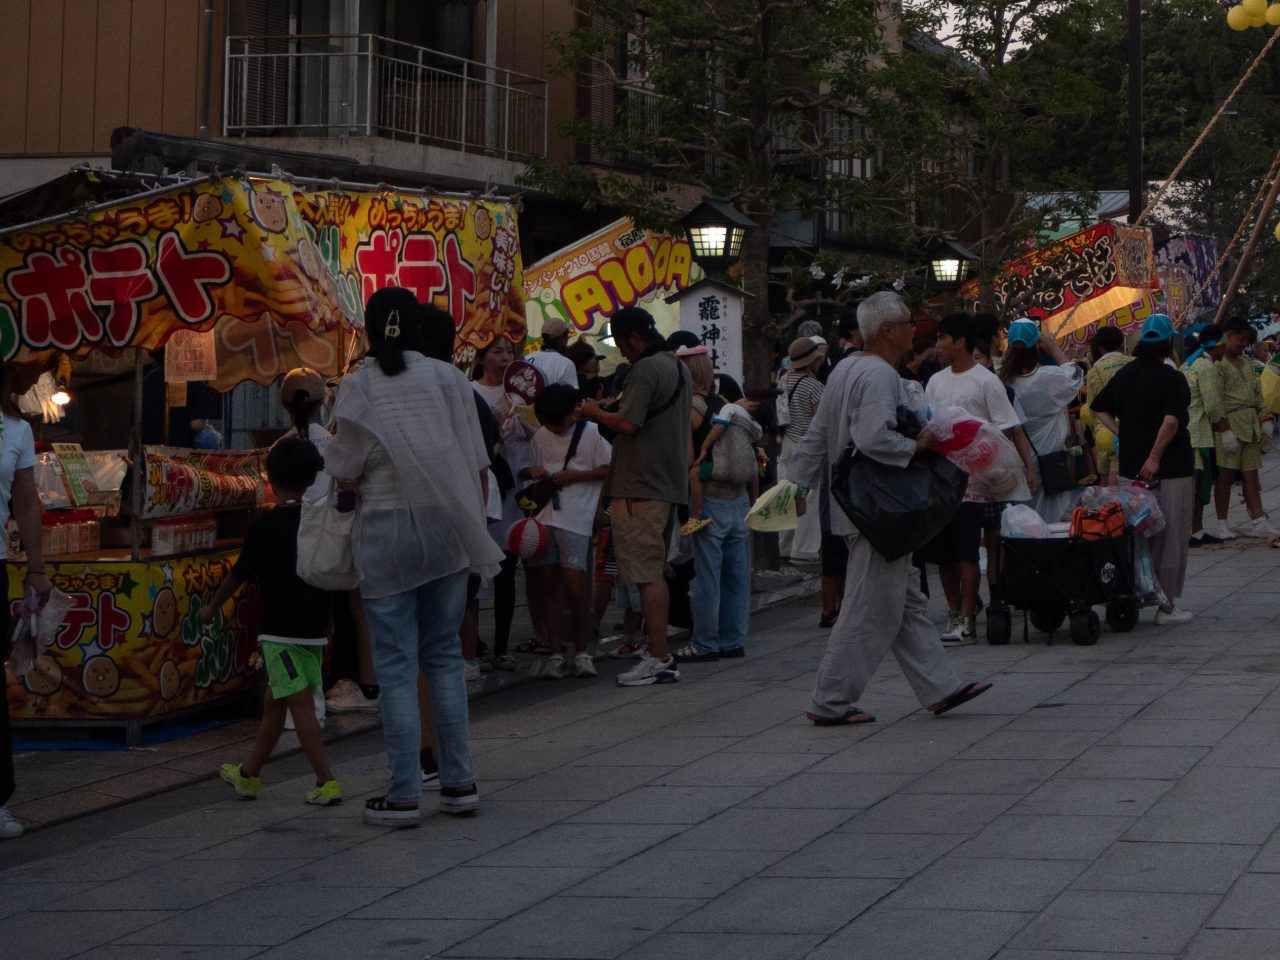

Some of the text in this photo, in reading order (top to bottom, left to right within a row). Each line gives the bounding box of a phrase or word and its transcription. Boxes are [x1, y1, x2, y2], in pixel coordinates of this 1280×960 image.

[6, 231, 232, 351] ポテト
[356, 227, 478, 334] ポテト
